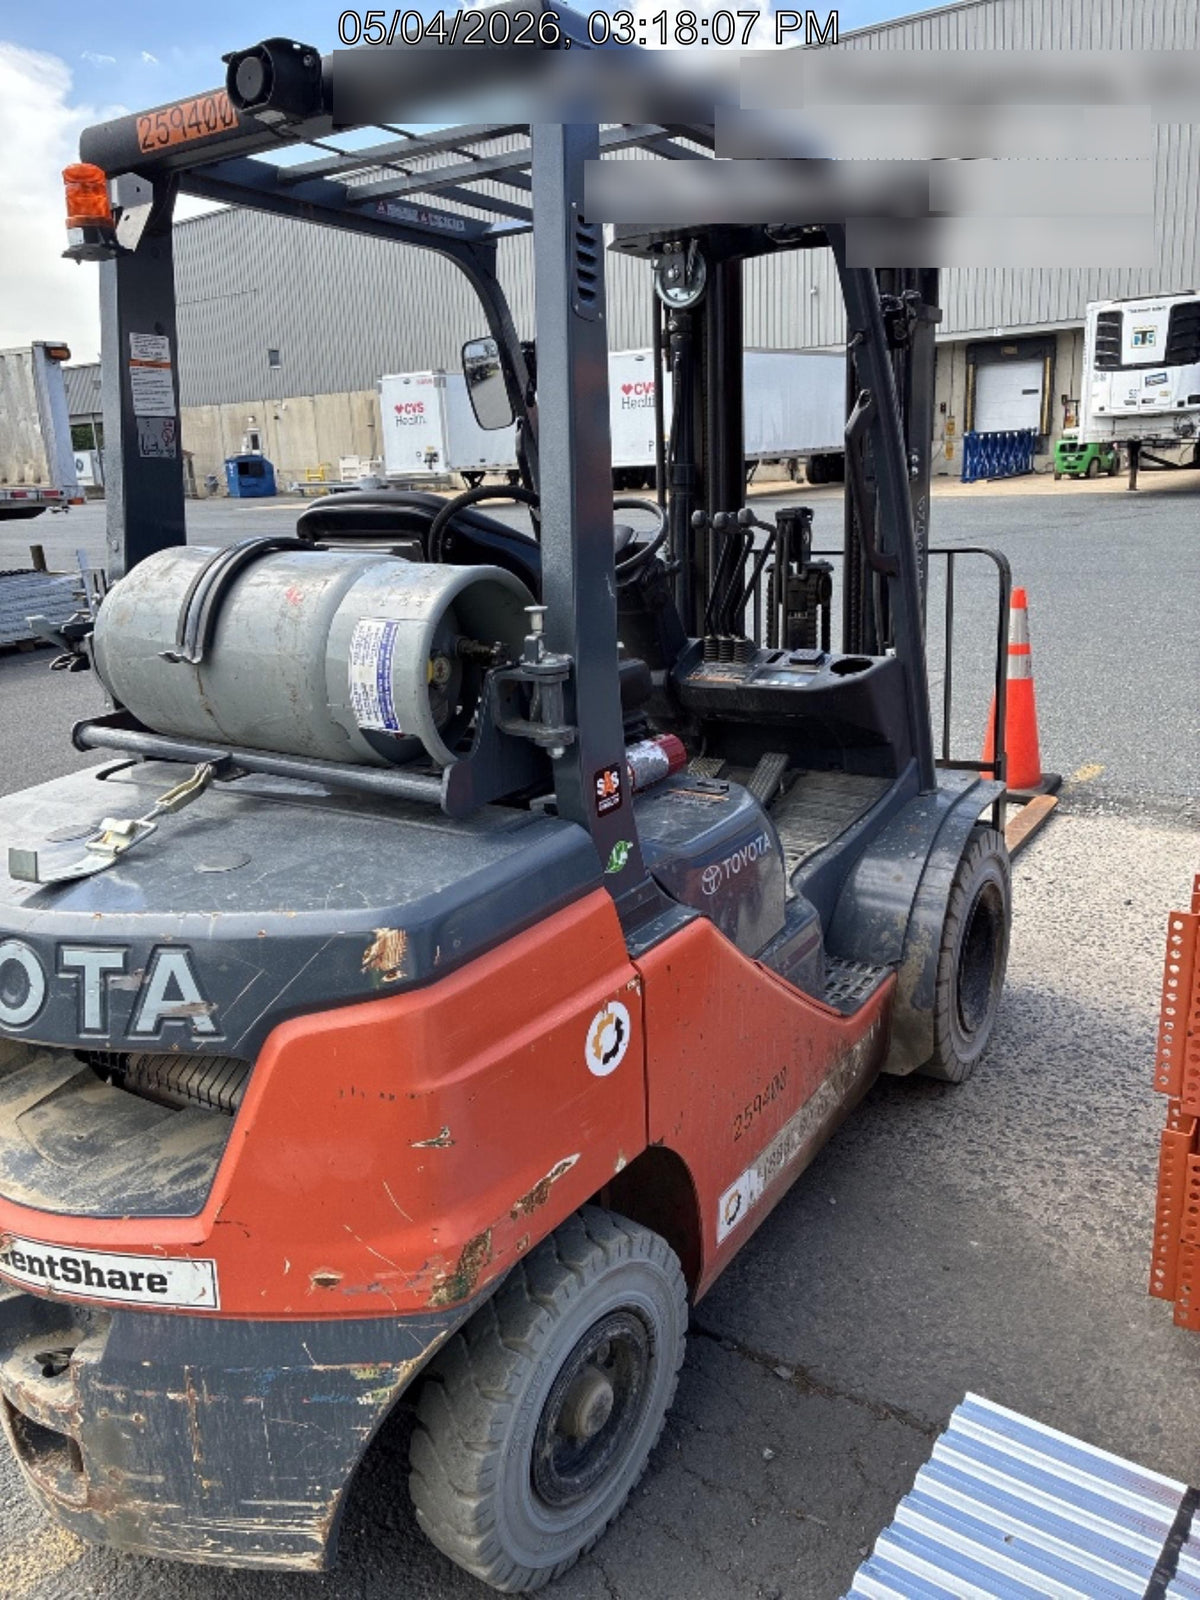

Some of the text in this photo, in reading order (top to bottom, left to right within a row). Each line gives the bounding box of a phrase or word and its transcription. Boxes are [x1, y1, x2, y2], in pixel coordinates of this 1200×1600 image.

[139, 94, 234, 149] 259400
[404, 402, 425, 414] CVS
[721, 831, 772, 879] TOYOTA
[0, 939, 216, 1032] OTA
